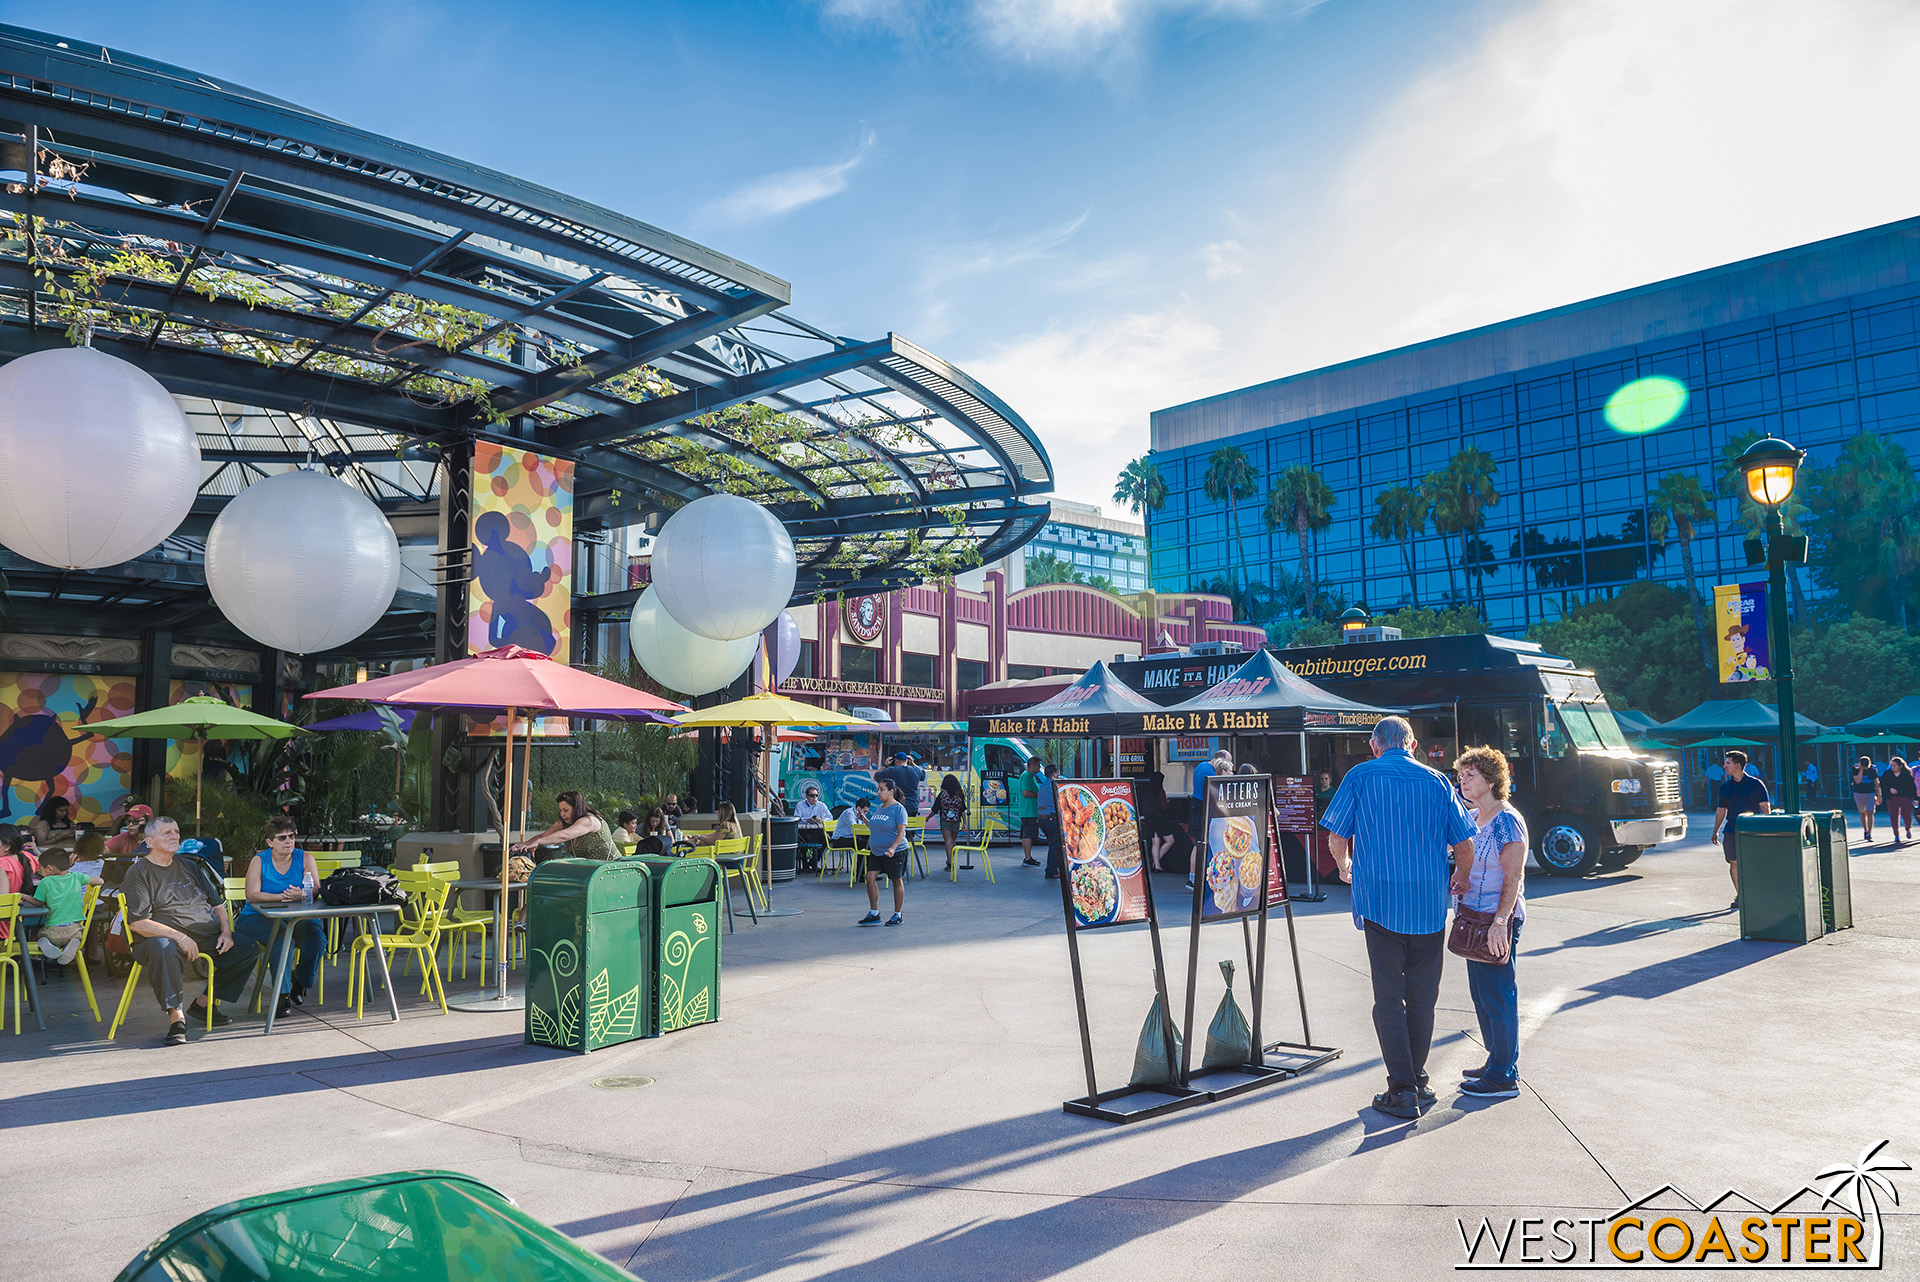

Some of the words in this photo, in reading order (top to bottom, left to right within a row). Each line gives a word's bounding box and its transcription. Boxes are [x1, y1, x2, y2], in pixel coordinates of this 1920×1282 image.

[851, 612, 882, 637] SANDWICH
[43, 662, 102, 671] TICKETS
[205, 671, 244, 681] TICKETS
[780, 676, 797, 689] HE
[800, 677, 844, 692] WORLD'S
[845, 681, 889, 695] GREATEST
[890, 685, 905, 697] HOT
[905, 686, 945, 700] SANDWICH
[1144, 668, 1181, 689] MAKE
[1184, 672, 1194, 681] IT
[1195, 671, 1203, 680] A
[1201, 676, 1272, 700] Habit
[989, 719, 1022, 733] Make
[1026, 718, 1036, 733] It
[1039, 718, 1049, 732] A
[1053, 718, 1090, 732] Habit
[1143, 714, 1185, 731] Make
[1189, 713, 1201, 730] It
[1205, 712, 1218, 729] A
[1223, 711, 1269, 729] Habit
[1305, 712, 1337, 726] Inquiries:
[1218, 782, 1259, 801] AFTERS
